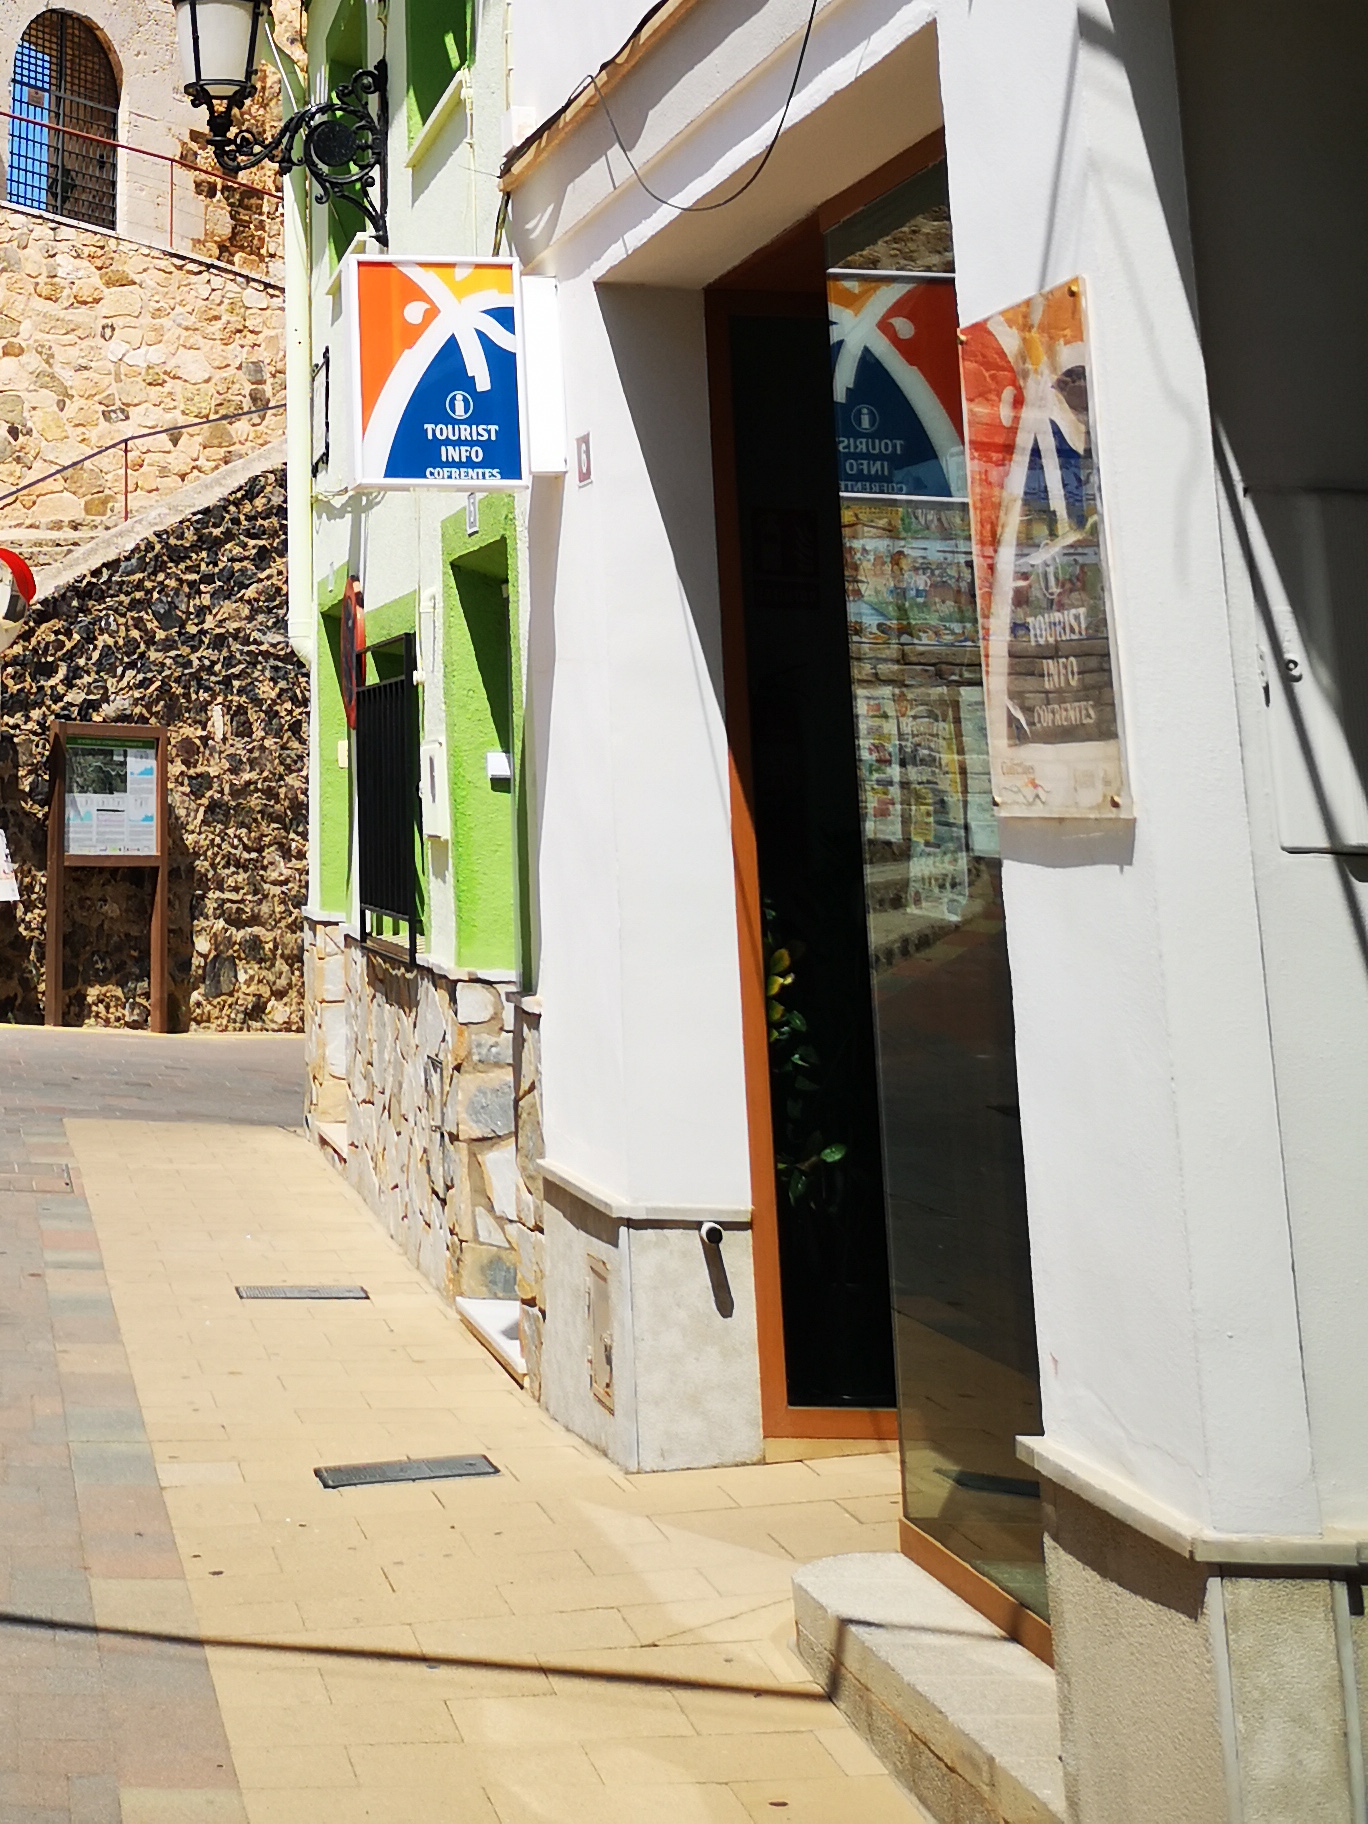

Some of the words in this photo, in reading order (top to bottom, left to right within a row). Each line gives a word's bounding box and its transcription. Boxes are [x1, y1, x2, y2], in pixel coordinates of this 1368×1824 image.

[423, 423, 499, 441] TOURIST
[440, 445, 484, 463] INFO
[581, 442, 587, 474] 6
[425, 467, 501, 480] COFRENTES
[1027, 607, 1088, 646] TOURIST
[1042, 656, 1078, 690] INFO
[1034, 700, 1096, 727] COFRENTES
